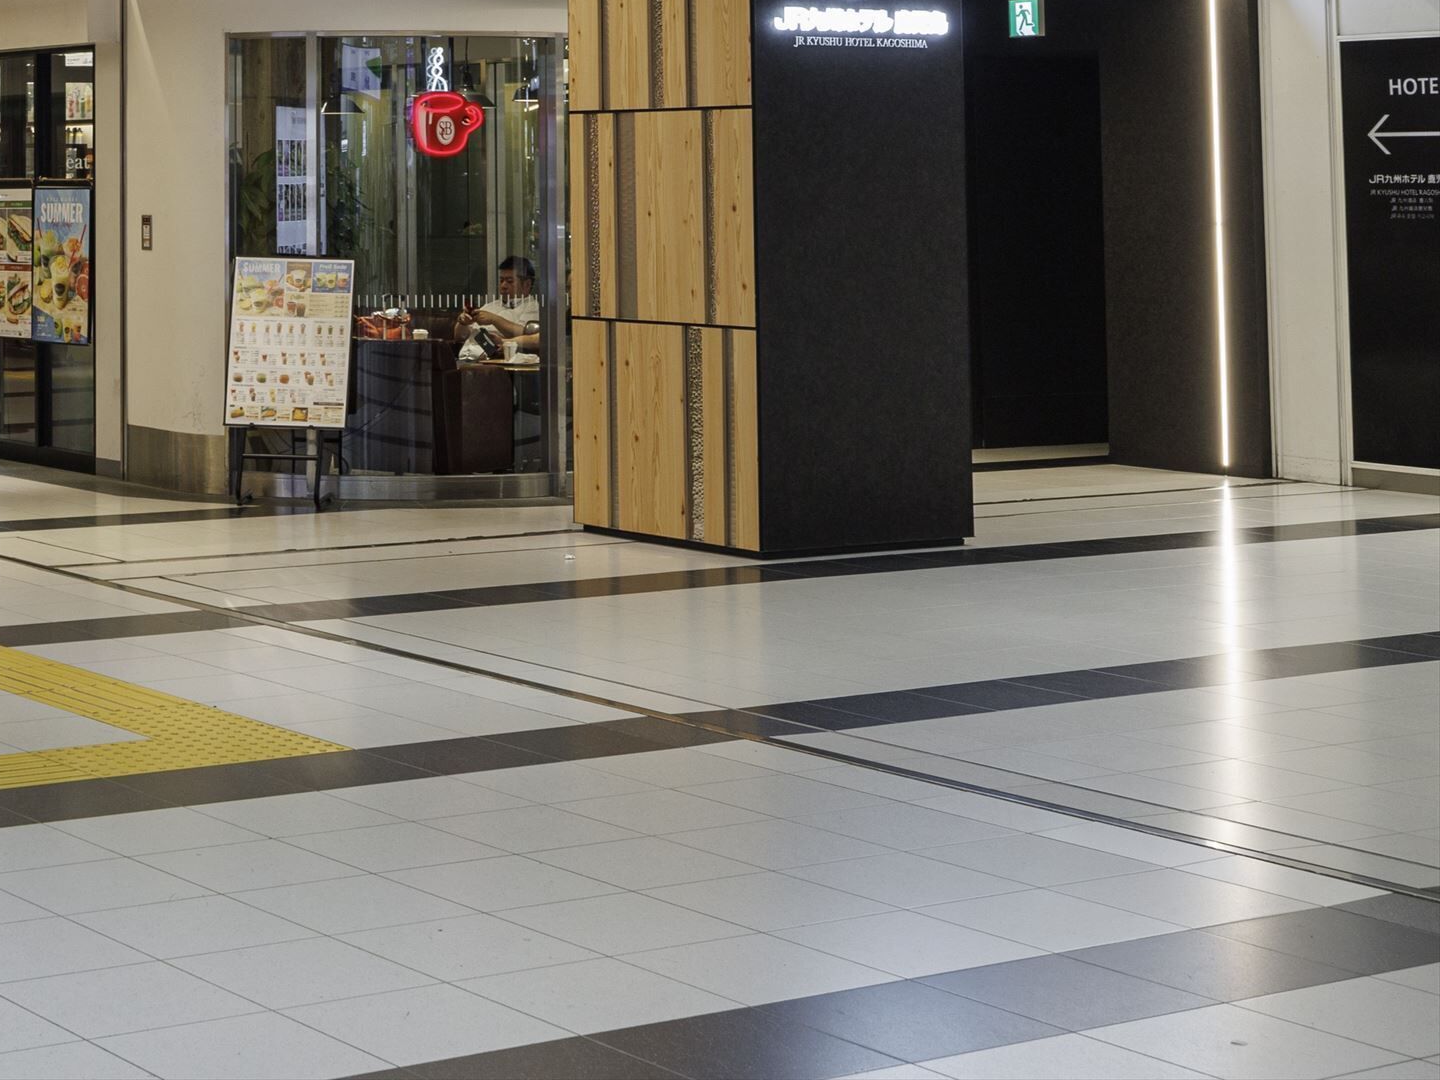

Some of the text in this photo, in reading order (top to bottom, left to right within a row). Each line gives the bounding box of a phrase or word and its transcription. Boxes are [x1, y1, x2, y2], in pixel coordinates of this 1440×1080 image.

[793, 36, 929, 48] JR KYUSHU HOTEL KAGOSHIMA
[1389, 77, 1439, 95] HOTE
[40, 201, 84, 223] SUMMER
[243, 262, 281, 273] SUMMER
